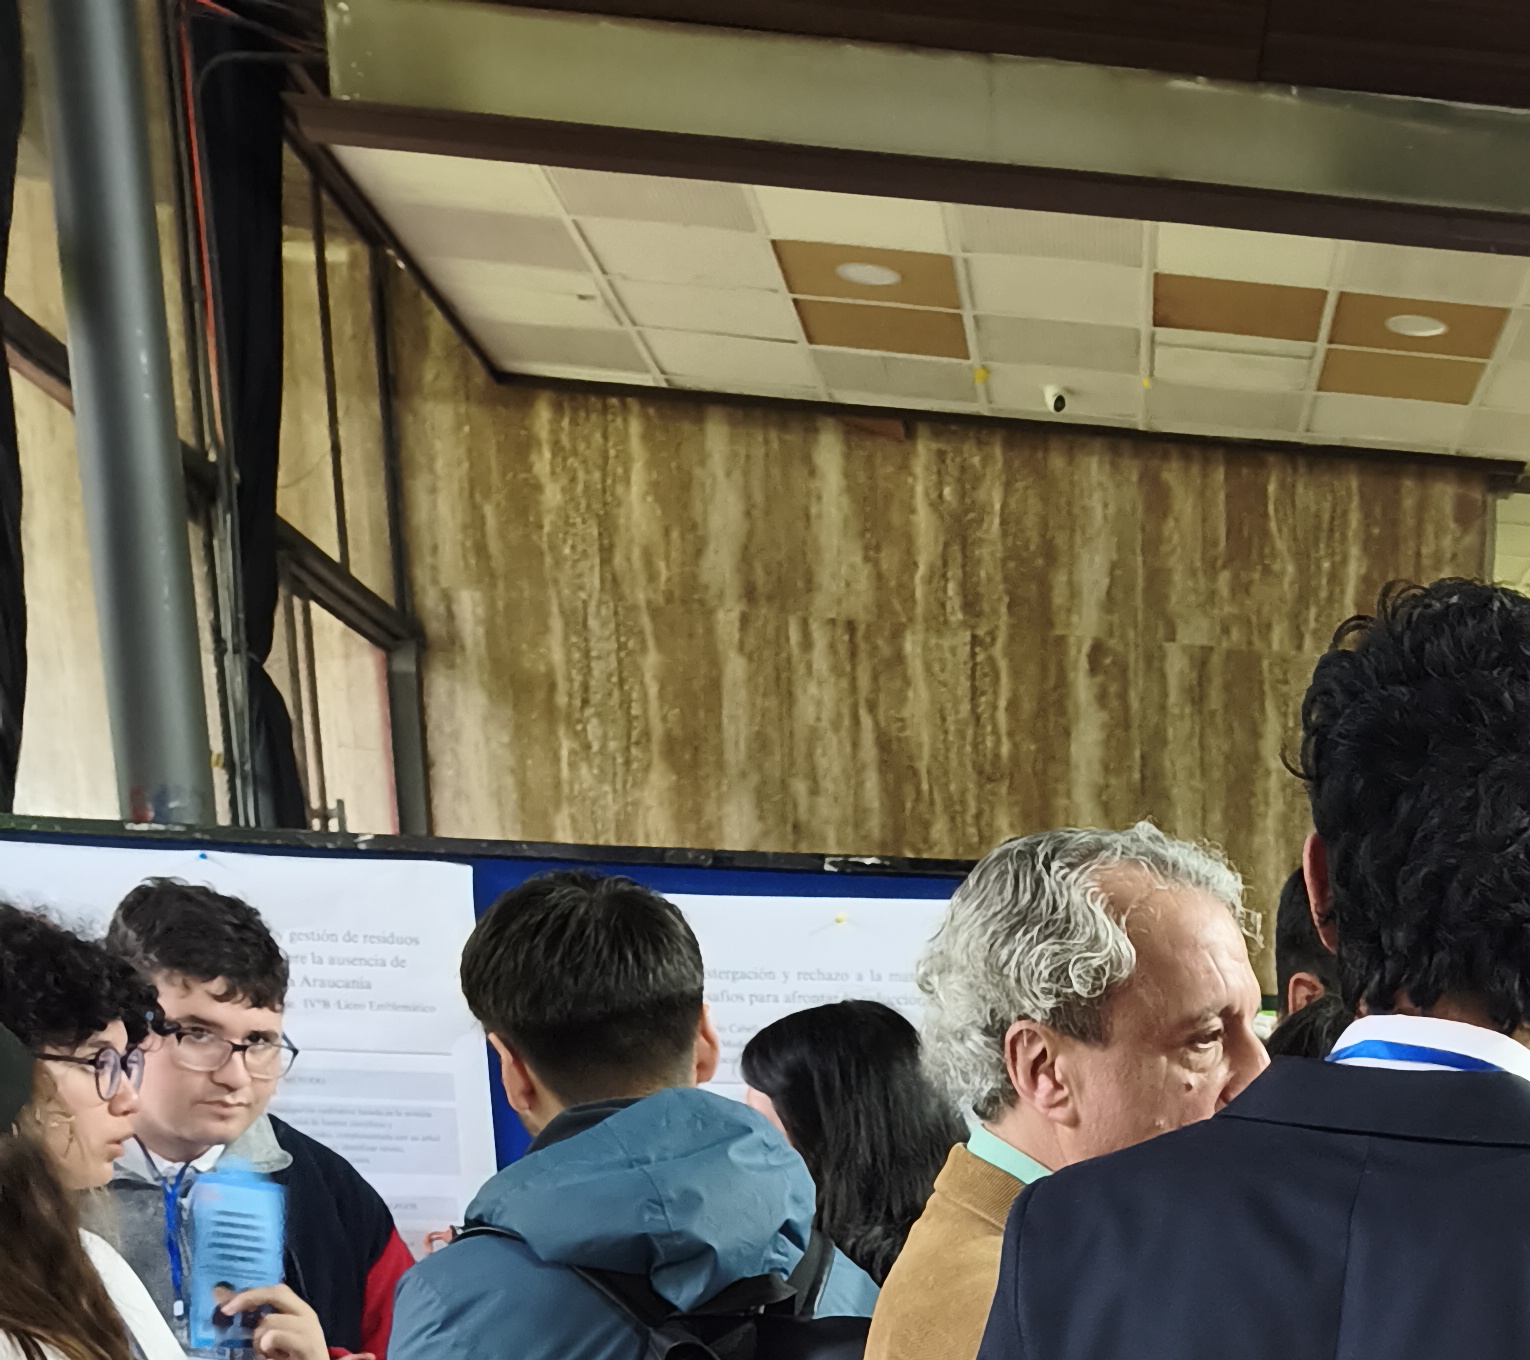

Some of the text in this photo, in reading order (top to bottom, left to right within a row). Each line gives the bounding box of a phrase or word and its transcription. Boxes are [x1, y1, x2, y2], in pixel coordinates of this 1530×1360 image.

[289, 929, 339, 944] gestión
[342, 930, 359, 943] de
[363, 931, 420, 946] residuos
[311, 951, 324, 965] la
[328, 953, 387, 968] ausencia
[390, 955, 407, 968] de
[300, 975, 372, 990] Araucanía
[797, 968, 849, 983] rechazo
[749, 993, 779, 1006] para
